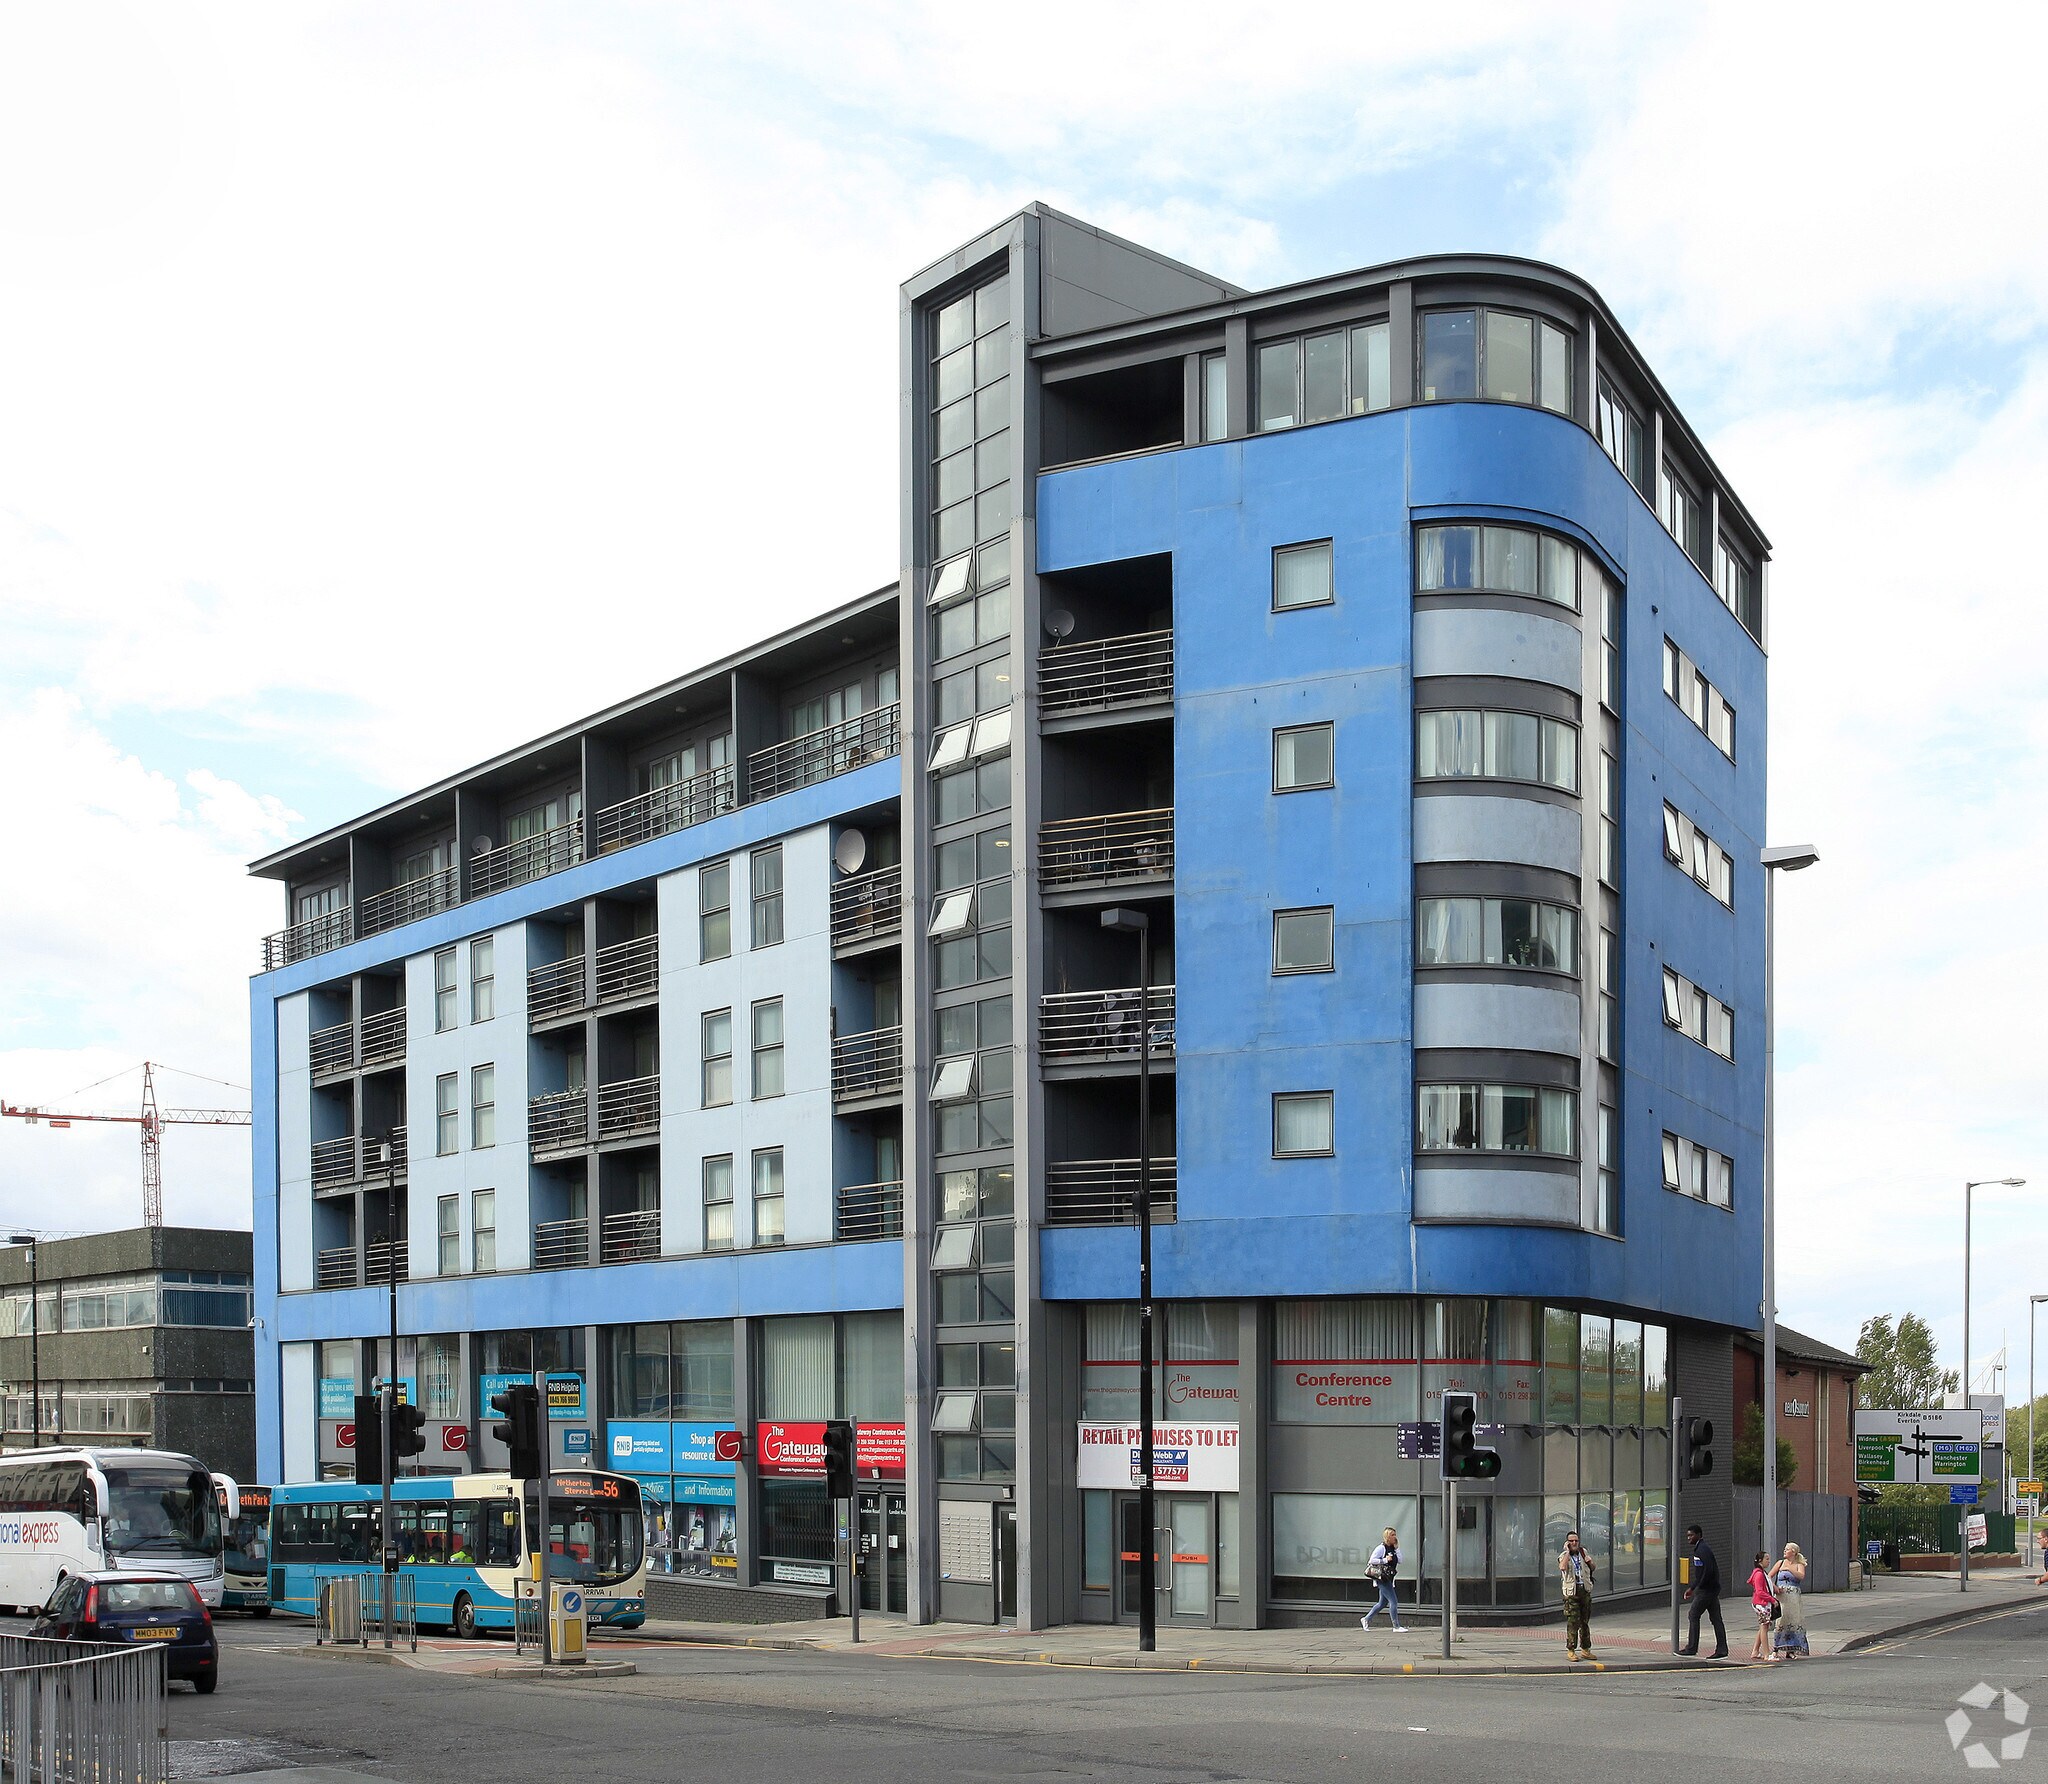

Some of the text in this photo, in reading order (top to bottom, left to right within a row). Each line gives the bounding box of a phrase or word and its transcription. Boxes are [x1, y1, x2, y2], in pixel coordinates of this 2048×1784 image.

[1176, 1373, 1190, 1382] The
[1295, 1373, 1392, 1387] Conference
[1168, 1380, 1239, 1404] Gateway
[1315, 1392, 1372, 1407] Centre
[771, 1425, 784, 1436] The
[690, 1433, 715, 1447] Shop an
[1083, 1428, 1239, 1447] RETAIL PRMISES TO LET
[616, 1441, 631, 1452] RNIB
[682, 1452, 707, 1461] resource
[1158, 1467, 1187, 1475] 577577
[557, 1479, 590, 1487] Netherton
[603, 1481, 618, 1498] 56
[590, 1488, 604, 1496] Lane
[684, 1484, 733, 1497] and Information
[253, 1493, 268, 1506] Park
[22, 1521, 60, 1552] express
[135, 1628, 175, 1638] MM03 FVK
